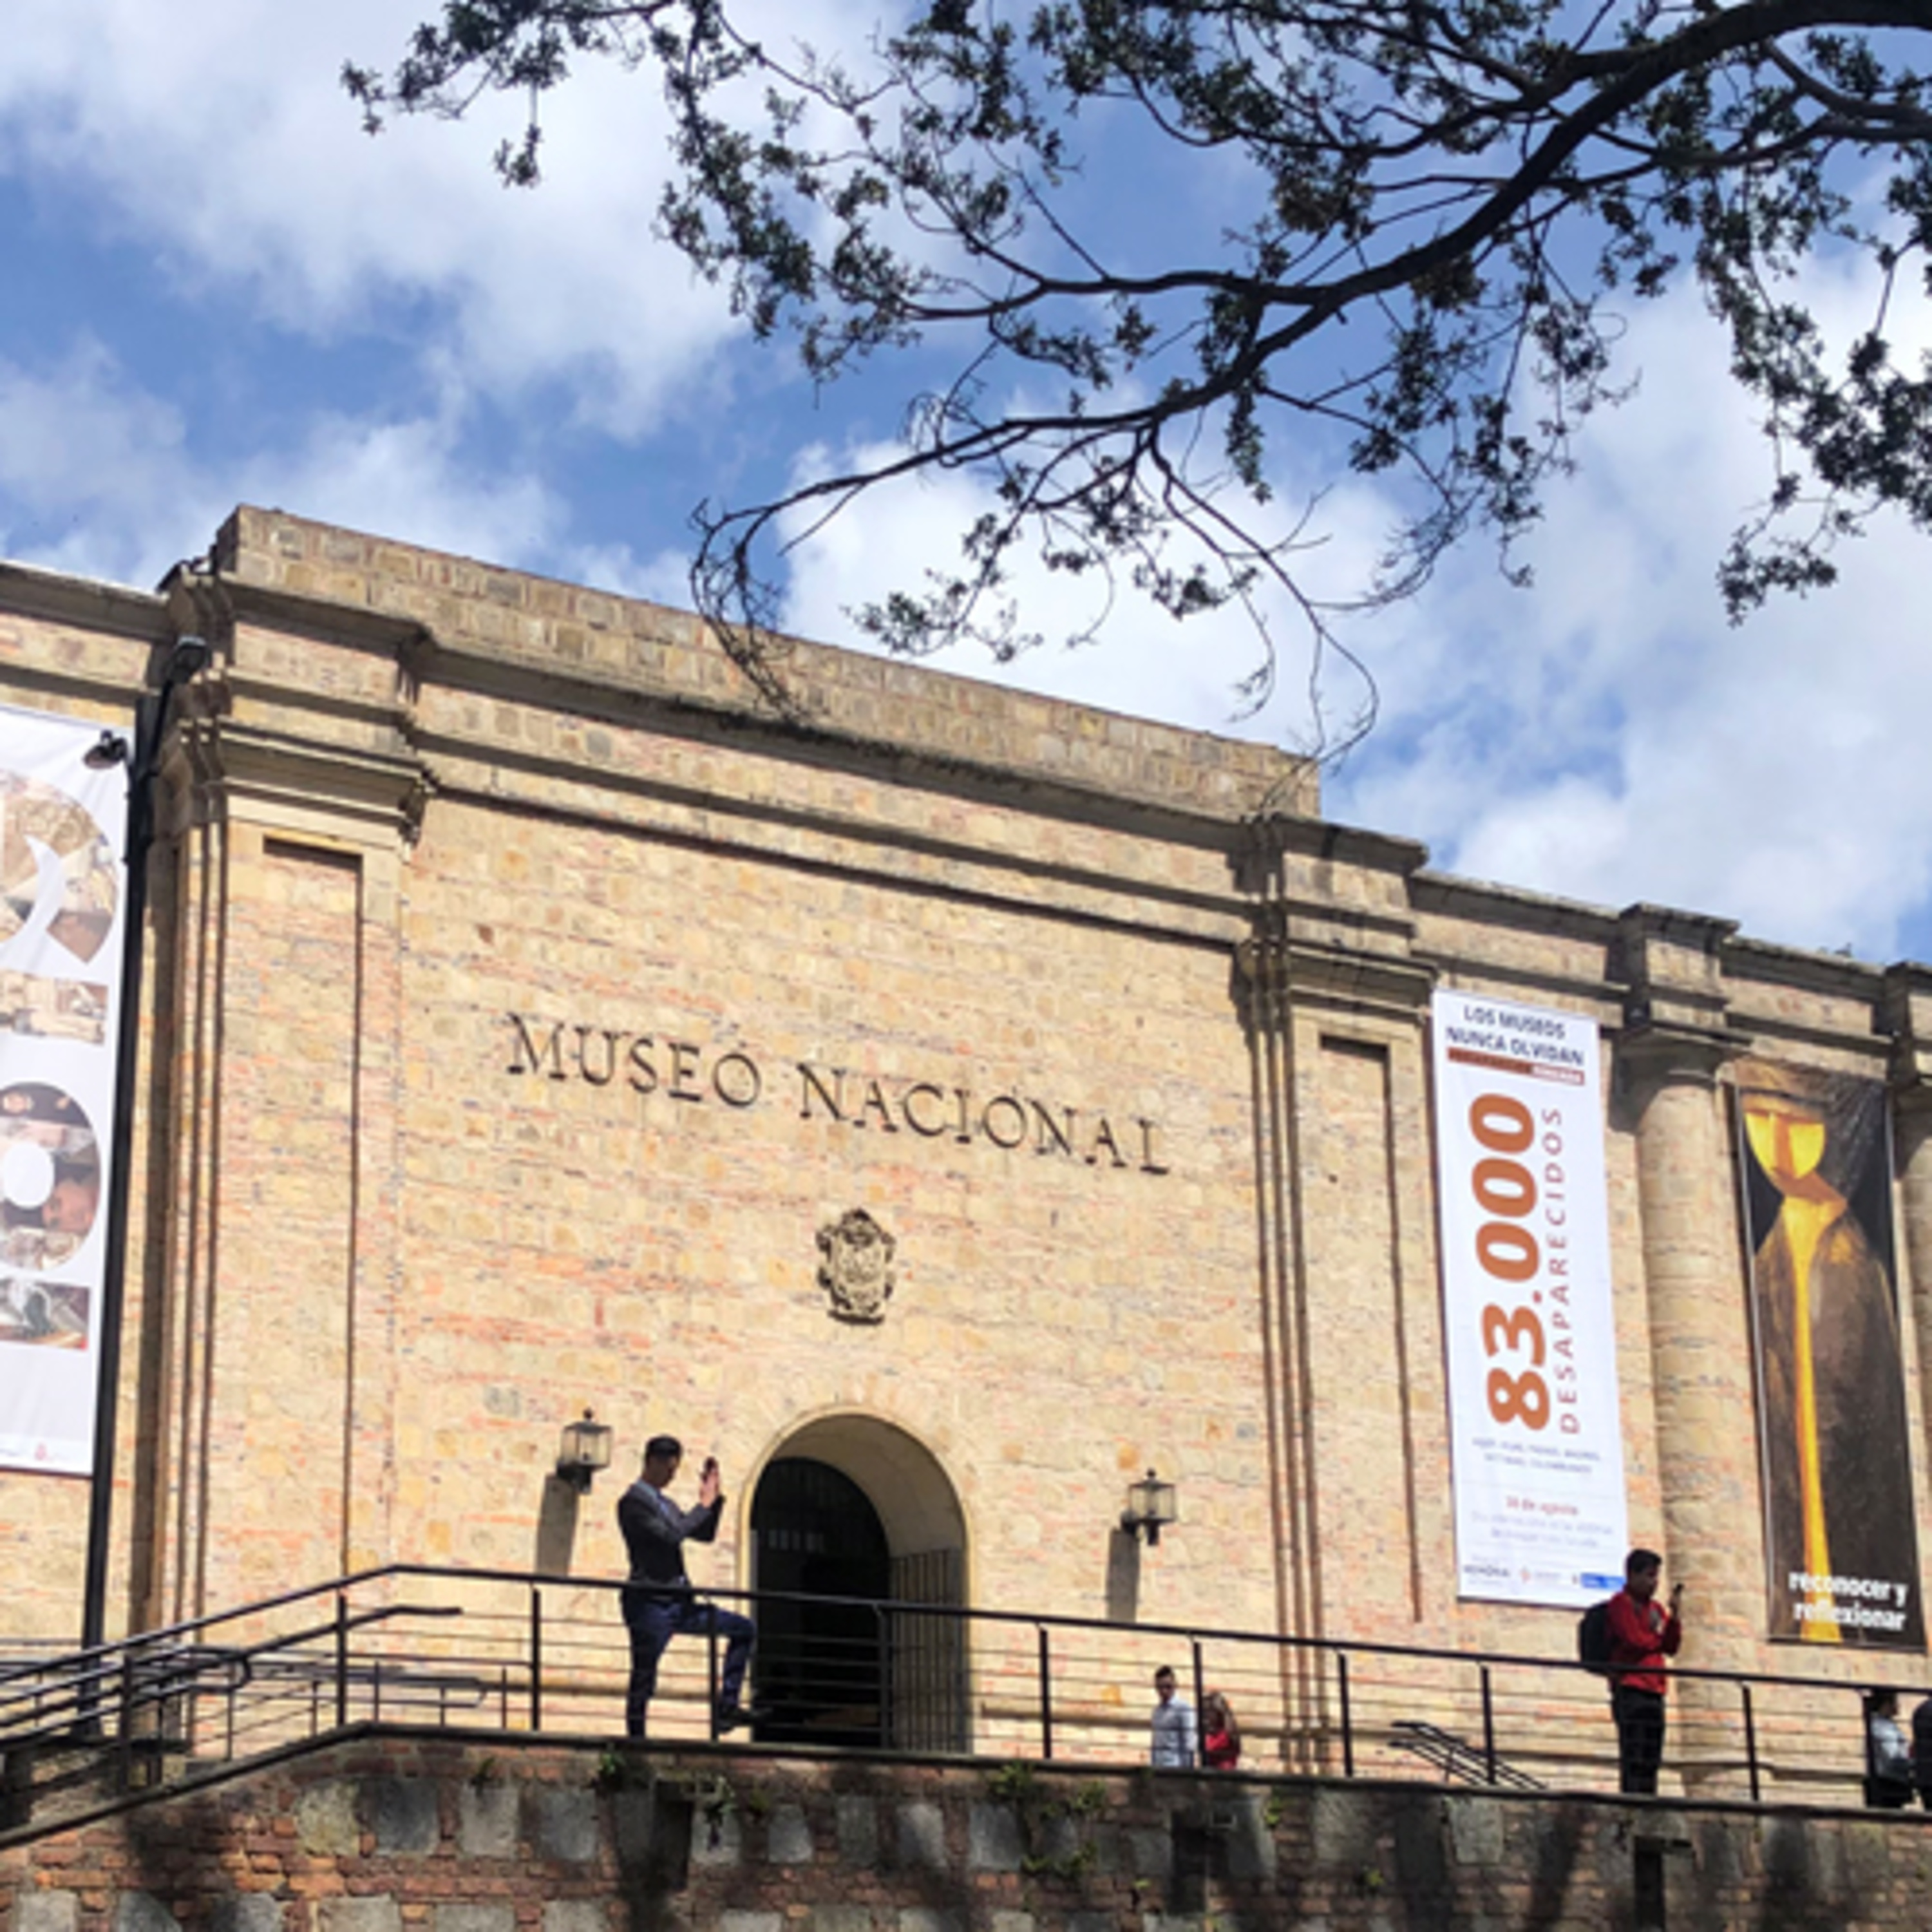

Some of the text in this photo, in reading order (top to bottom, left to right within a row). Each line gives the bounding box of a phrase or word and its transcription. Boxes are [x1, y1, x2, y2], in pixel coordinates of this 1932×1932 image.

[1463, 1005, 1566, 1039] LOS MUSEOS
[1446, 1026, 1506, 1051] NUNCA
[1510, 1038, 1584, 1066] OLVIDAN
[506, 1012, 1170, 1176] MUSEO NACIONAL
[1468, 1093, 1551, 1431] 83.000
[1541, 1108, 1580, 1434] DESAPARECIDOS
[1788, 1571, 1908, 1607] reconocer y
[1793, 1598, 1906, 1631] reflexionar
